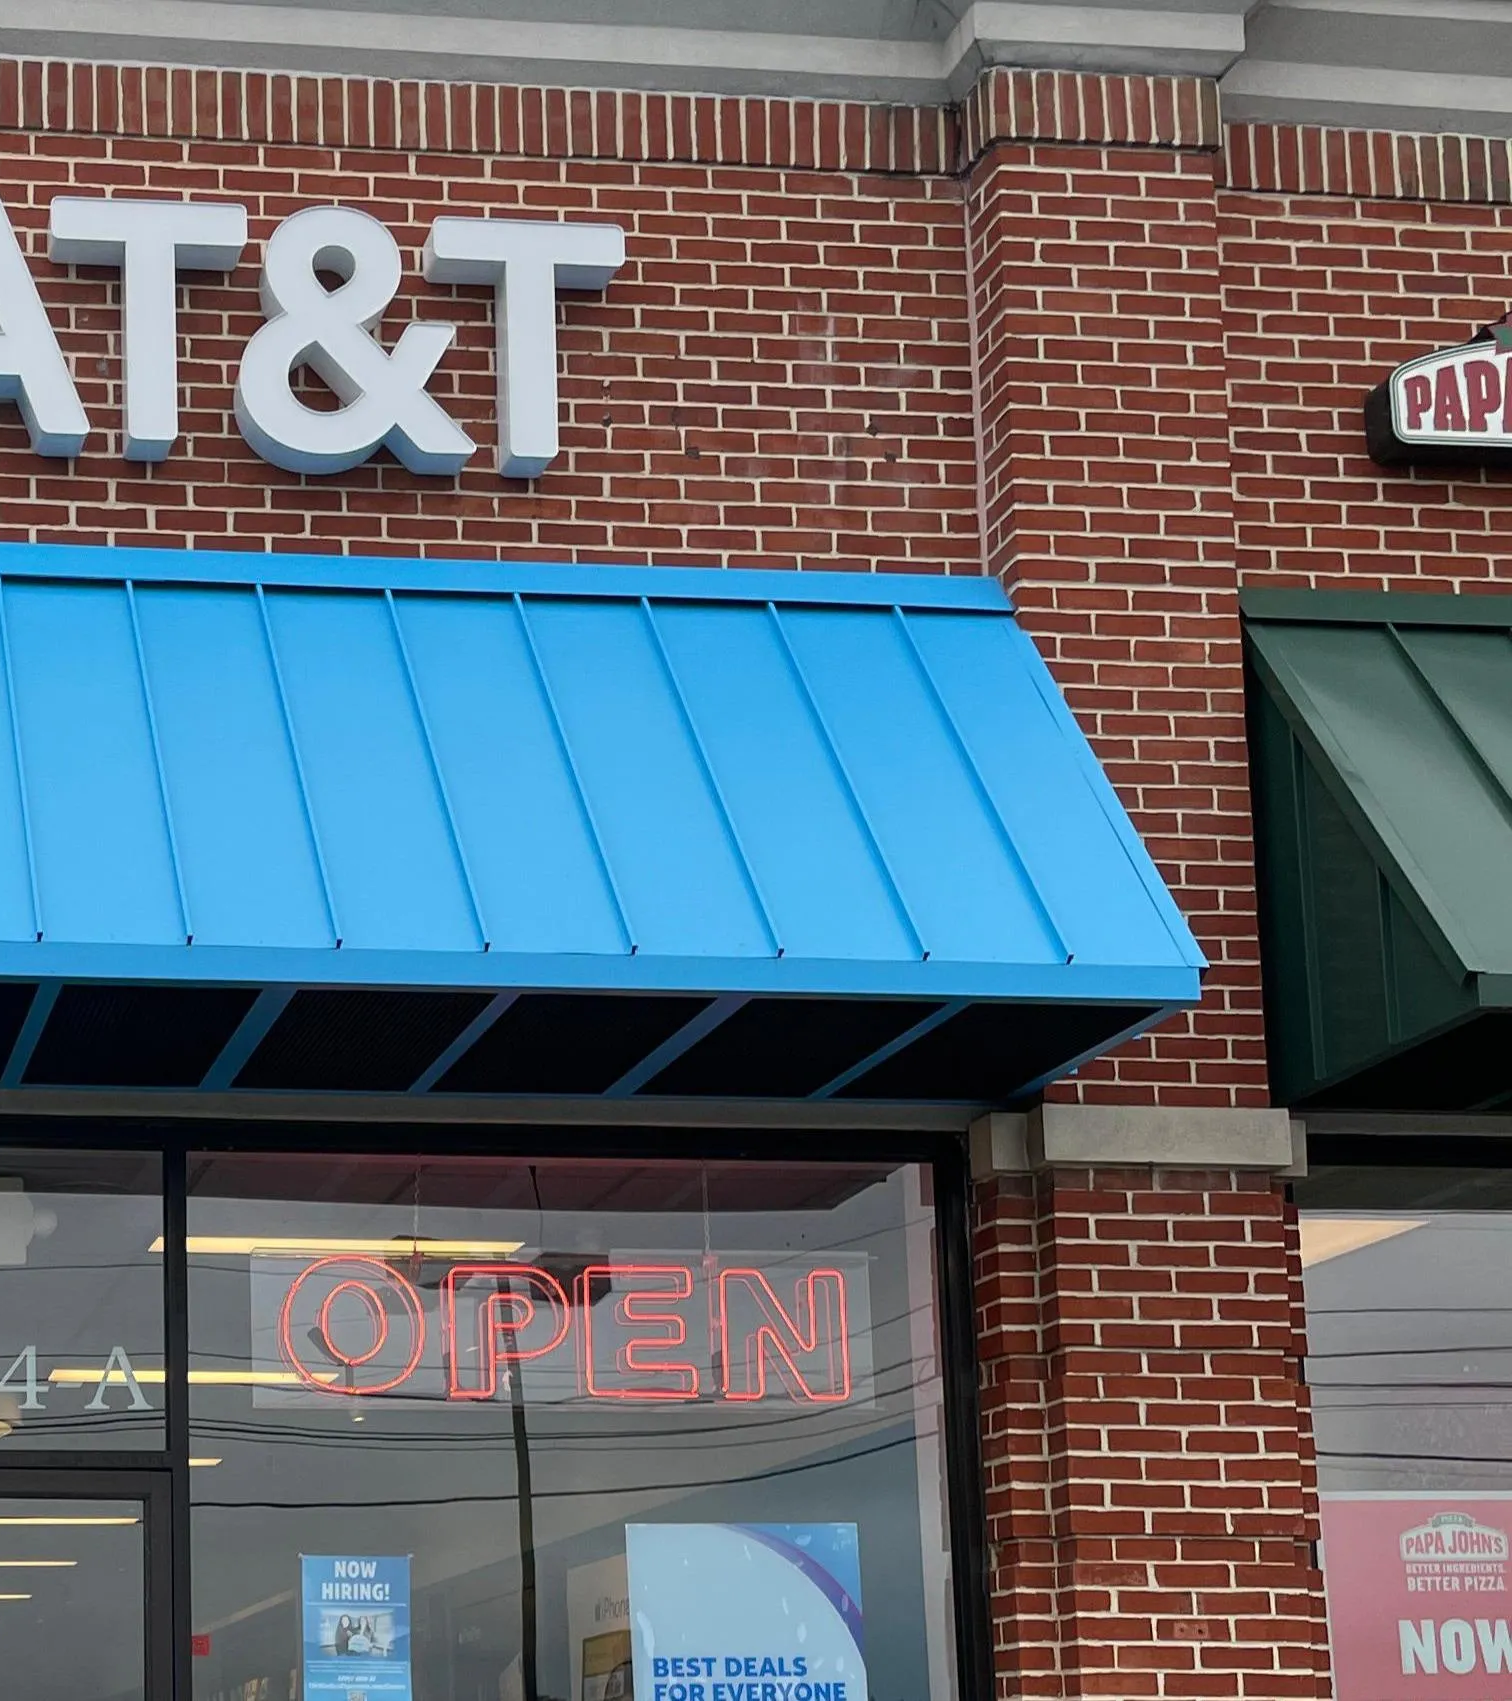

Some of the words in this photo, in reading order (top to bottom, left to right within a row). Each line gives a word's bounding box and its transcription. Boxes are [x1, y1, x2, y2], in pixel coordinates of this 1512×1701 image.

[1404, 357, 1512, 433] PAP
[281, 1255, 850, 1400] OPEN
[1405, 1531, 1445, 1555] PAPA
[1448, 1530, 1504, 1555] JOHN'S
[334, 1560, 377, 1579] NOW
[1405, 1563, 1440, 1574] BETTER
[321, 1582, 390, 1601] HIRING!
[1407, 1576, 1461, 1592] BETTER
[1398, 1618, 1512, 1675] NOW
[652, 1657, 716, 1678] BEST
[724, 1656, 808, 1678] DEALS
[654, 1683, 705, 1701] FOR
[712, 1682, 846, 1701] EVERYONE
